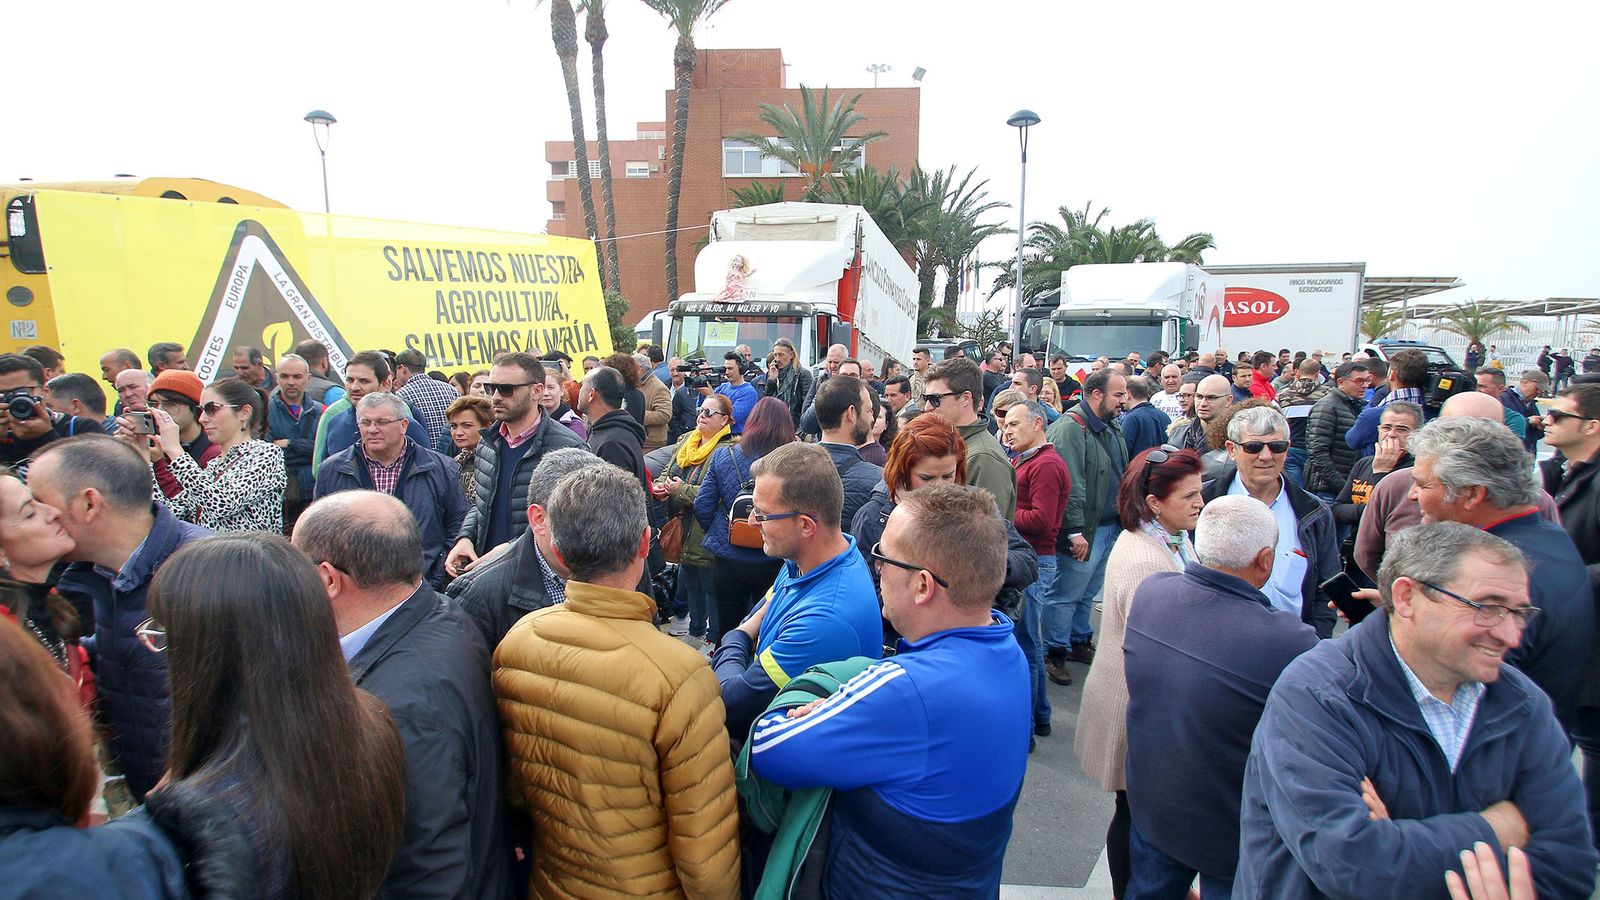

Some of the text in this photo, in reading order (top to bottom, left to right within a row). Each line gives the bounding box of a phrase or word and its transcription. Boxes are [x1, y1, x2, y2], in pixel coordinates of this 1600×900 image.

[383, 245, 585, 285] SALVEMOS NUESTRA
[225, 264, 249, 310] EUROPA
[273, 272, 288, 289] LA
[286, 288, 311, 320] GRAN
[436, 290, 569, 325] AGRICULTURA,
[685, 303, 697, 313] MIS
[698, 303, 704, 313] 2
[726, 303, 736, 313] MI
[736, 303, 762, 313] MUJER
[762, 303, 769, 313] Y
[769, 303, 780, 313] YO
[198, 335, 224, 381] COSTES
[405, 329, 521, 368] SALVEMOS
